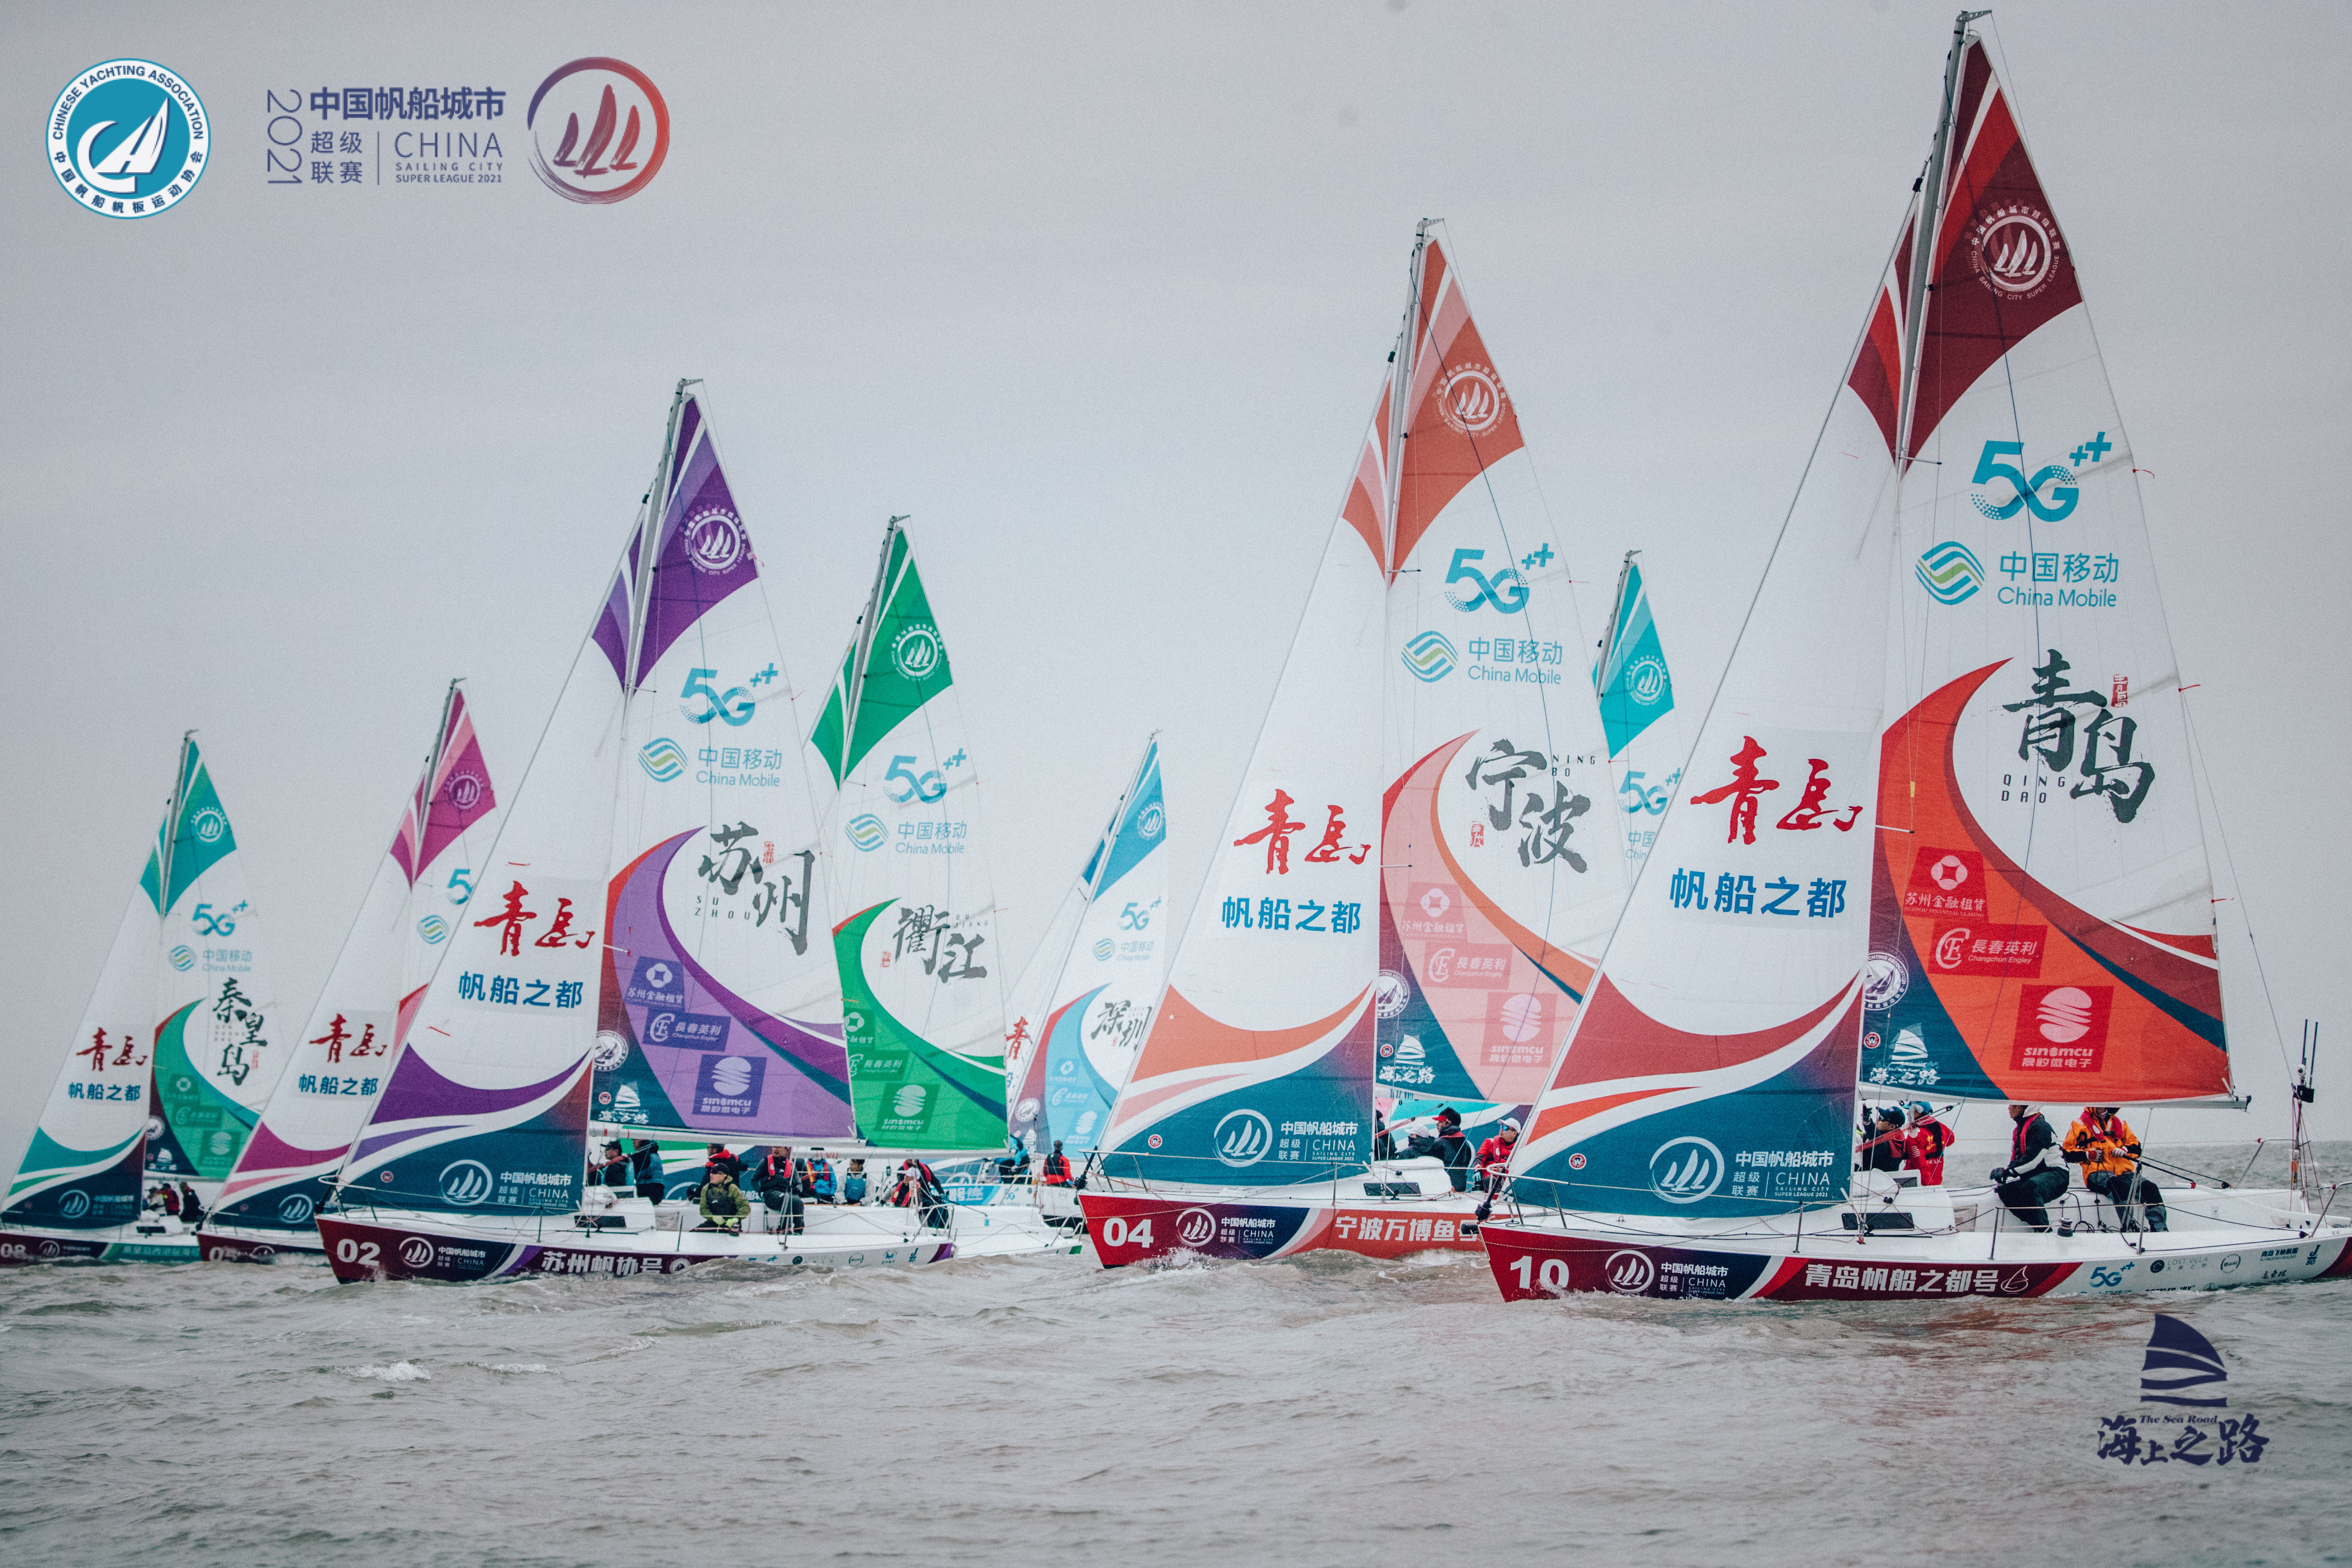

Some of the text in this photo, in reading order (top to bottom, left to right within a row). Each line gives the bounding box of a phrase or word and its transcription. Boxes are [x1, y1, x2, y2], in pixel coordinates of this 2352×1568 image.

[1971, 251, 1980, 273] CHINA
[2027, 283, 2047, 299] SUPER
[2047, 255, 2060, 282] LEAGUE
[2000, 551, 2119, 583] 中国移动
[1997, 587, 2116, 607] China Mobile
[1469, 637, 1562, 665] 中国移动
[1468, 665, 1561, 684] China Mobile
[698, 746, 782, 770] 中国移动
[1553, 755, 1596, 765] NING
[696, 771, 780, 786] China Mobile
[1552, 767, 1571, 777] BO
[2003, 774, 2065, 787] QING
[2002, 791, 2046, 802] DAO
[1465, 738, 1591, 873] 宁波
[897, 821, 966, 839] 中国移动
[896, 842, 964, 854] China Mobile
[698, 821, 815, 956] 苏州
[1669, 868, 1847, 918] 帆船之都
[697, 896, 719, 905] SU
[1905, 892, 1985, 911] 苏州金融租赁
[695, 908, 750, 919] ZHOU
[1222, 896, 1361, 934] 帆船之都
[203, 949, 252, 962] 中国移动
[1968, 955, 2007, 964] Changchun
[459, 971, 583, 1008] 帆船之都
[68, 1082, 141, 1101] 帆船之都
[299, 1074, 378, 1095] 帆船之都
[1281, 1121, 1358, 1136] 中国帆船城市
[1279, 1139, 1301, 1148] 超级
[1313, 1139, 1355, 1151] CHINA
[1278, 1151, 1299, 1160] 联赛
[1736, 1150, 1834, 1167] 中国帆船城市
[500, 1171, 572, 1186] 中国帆船城市
[1733, 1171, 1760, 1182] 超级
[1776, 1173, 1830, 1185] CHINA
[530, 1188, 568, 1199] CHINA
[1732, 1185, 1758, 1196] 联赛
[1222, 1217, 1276, 1228] 中国帆船城市
[1103, 1217, 1153, 1248] 04
[1243, 1230, 1273, 1238] CHINA
[337, 1239, 380, 1266] 02
[458, 1258, 484, 1266] CHINA
[1661, 1262, 1729, 1277] 中国帆船城市
[1510, 1256, 1569, 1291] 10
[1660, 1275, 1678, 1283] 超级
[1805, 1264, 1999, 1292] 青岛帆船之都号
[1660, 1283, 1678, 1292] 联赛
[1688, 1277, 1725, 1288] CHINA
